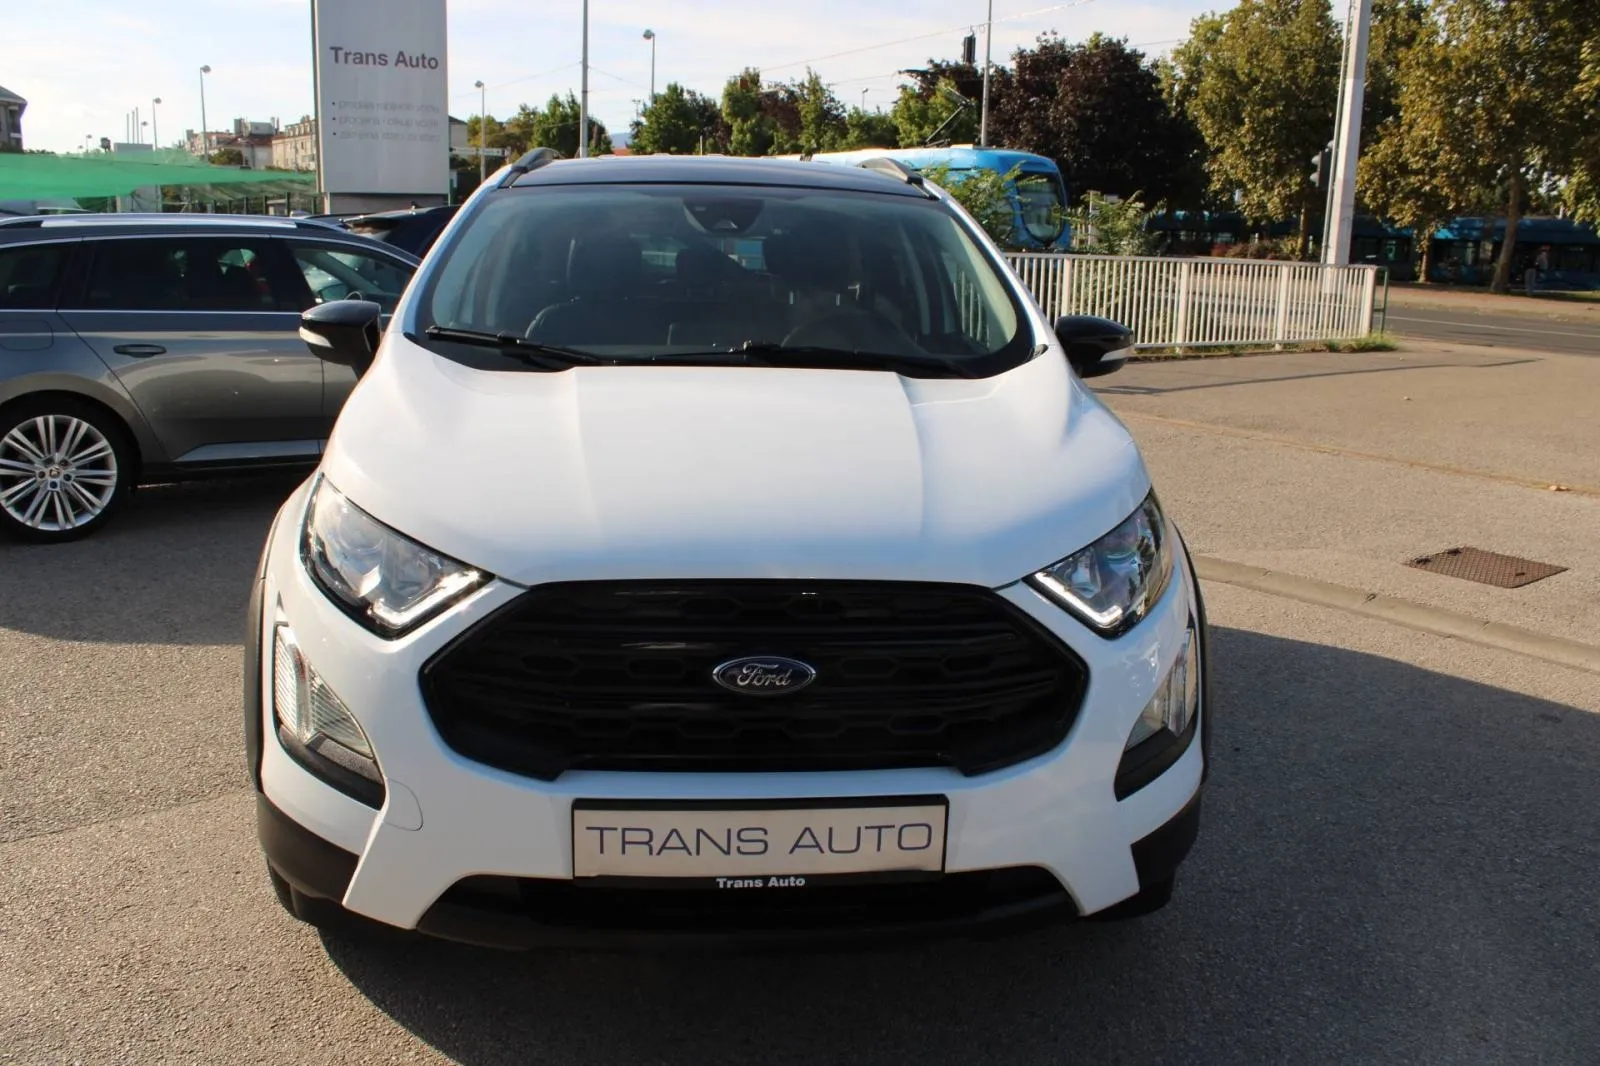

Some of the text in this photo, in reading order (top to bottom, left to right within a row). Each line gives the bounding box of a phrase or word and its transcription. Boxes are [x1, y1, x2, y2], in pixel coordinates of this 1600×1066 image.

[329, 46, 439, 69] Trans Auto
[737, 663, 793, 686] Ford
[585, 822, 932, 856] TRANS AUTO
[716, 876, 806, 889] Trans Auto
